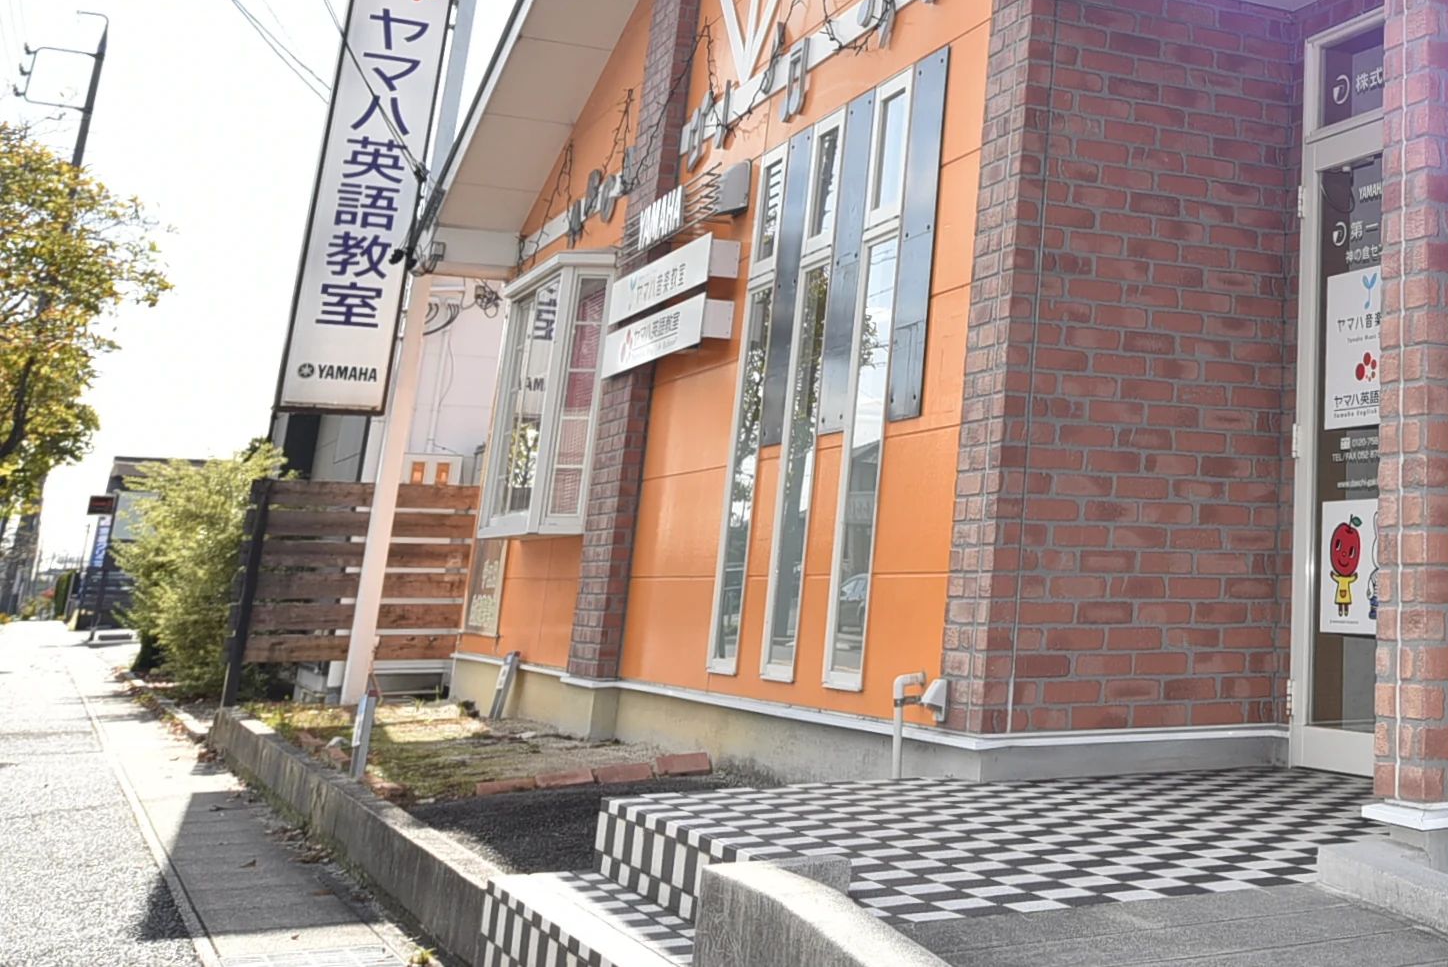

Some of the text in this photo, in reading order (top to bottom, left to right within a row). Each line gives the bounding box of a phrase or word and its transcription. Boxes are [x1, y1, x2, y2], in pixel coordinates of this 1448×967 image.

[315, 8, 429, 329] ヤマハ英語教室
[637, 185, 686, 251] YAMAHA
[1351, 221, 1379, 239] 第一
[318, 364, 377, 382] YAMAHA
